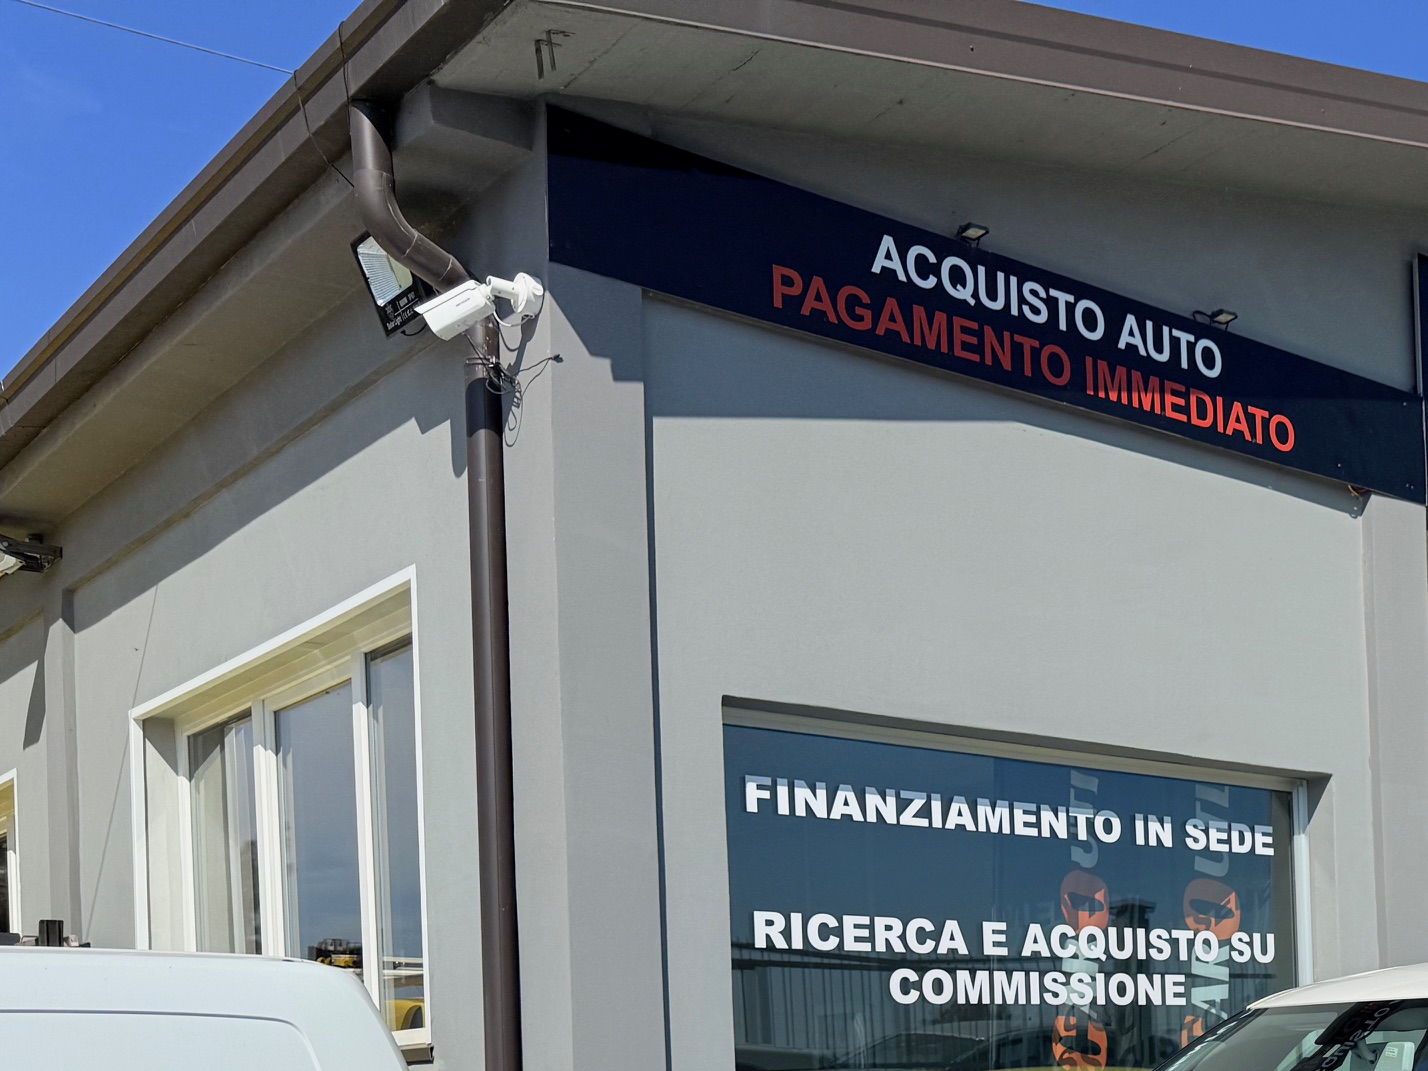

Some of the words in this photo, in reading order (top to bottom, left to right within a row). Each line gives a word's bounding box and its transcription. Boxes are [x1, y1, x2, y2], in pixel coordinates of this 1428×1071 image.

[872, 235, 1105, 341] ACQUISTO
[1118, 313, 1223, 379] AUTO
[771, 264, 1071, 386] PAGAMENTO
[1086, 356, 1295, 452] IMMEDIATO
[744, 774, 1122, 843] FINANZIAMENTO
[1135, 813, 1173, 848] IN
[1185, 818, 1275, 856] SEDE
[753, 911, 968, 958] RICERCA
[982, 921, 1009, 957] E
[1021, 923, 1219, 962] ACQUISTO
[1231, 932, 1275, 964] SU
[889, 968, 1187, 1006] COMMISSIONE
